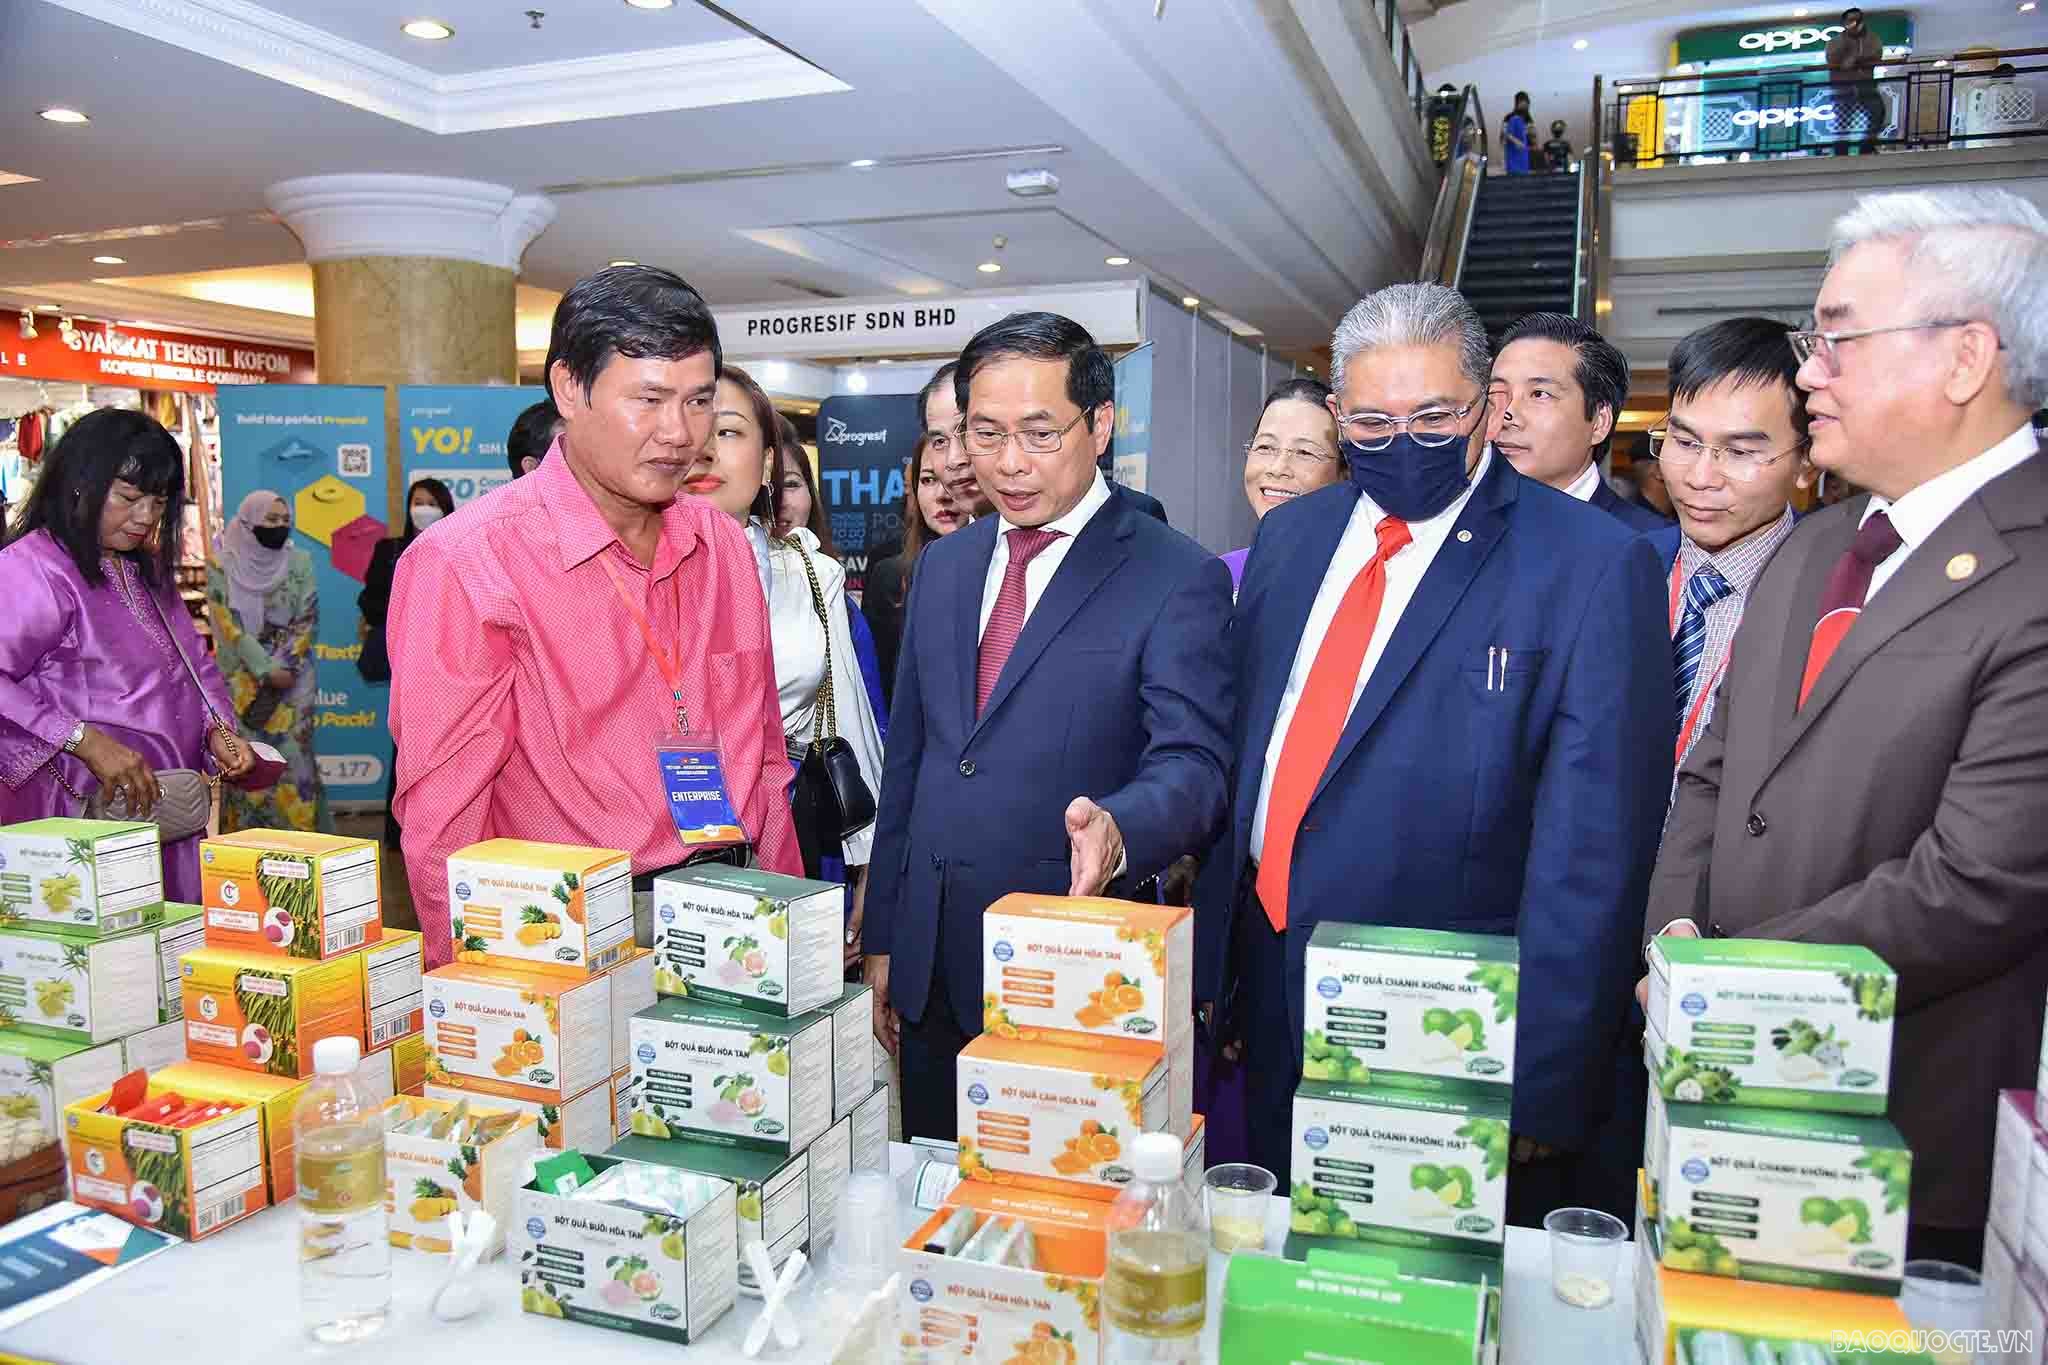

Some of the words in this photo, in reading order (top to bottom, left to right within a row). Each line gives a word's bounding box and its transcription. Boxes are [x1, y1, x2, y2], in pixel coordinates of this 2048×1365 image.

[747, 313, 856, 336] PROGRESIF
[866, 310, 904, 329] SDN
[915, 308, 956, 326] BHD
[160, 340, 232, 367] TEKSTIL
[233, 349, 291, 374] KOFOM
[411, 426, 474, 455] YO!
[671, 790, 722, 802] ENTERPRISE
